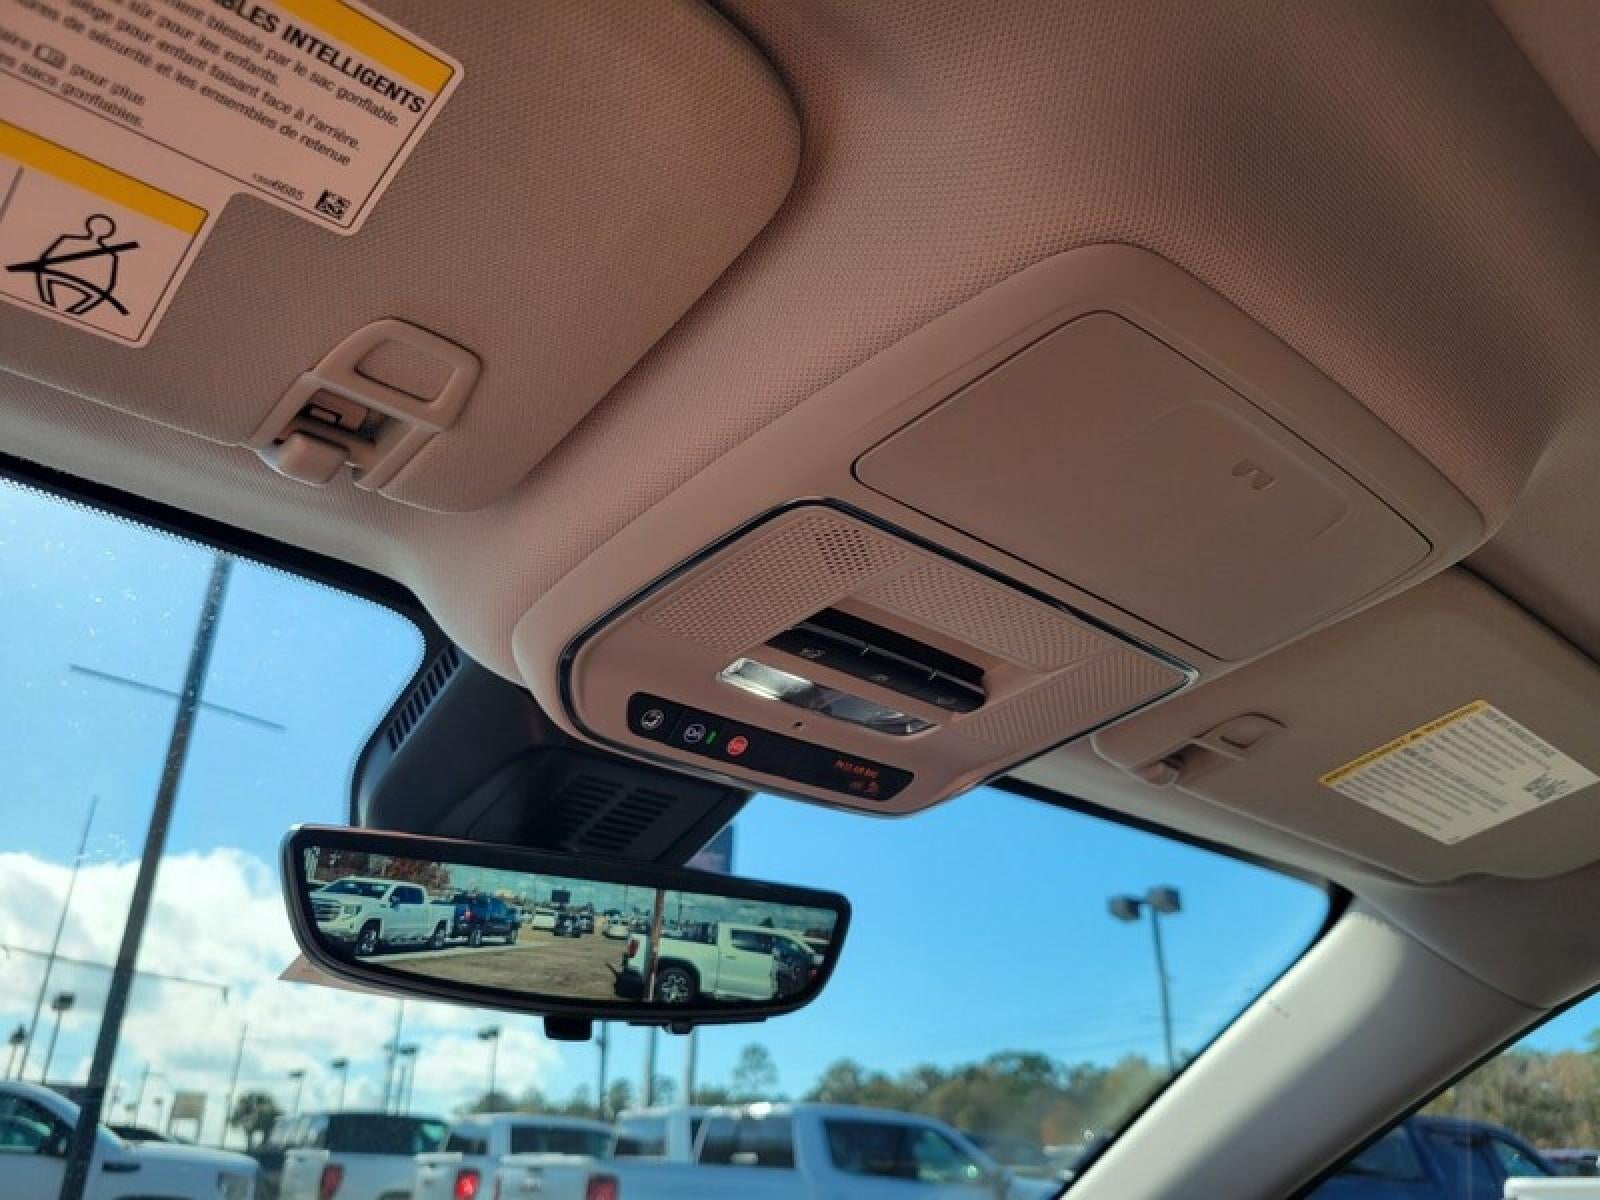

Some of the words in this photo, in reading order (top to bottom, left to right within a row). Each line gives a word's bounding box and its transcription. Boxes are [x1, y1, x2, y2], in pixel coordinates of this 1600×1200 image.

[115, 18, 153, 42] pour
[157, 39, 208, 71] enfant
[210, 64, 260, 98] faisant
[262, 91, 292, 114] face
[157, 15, 193, 40] pour
[198, 33, 221, 54] les
[214, 0, 279, 33] BLES
[282, 24, 425, 113] INTELLIGENTS
[70, 63, 109, 88] pour
[109, 81, 145, 106] plus
[265, 48, 291, 67] par
[293, 62, 308, 77] le
[310, 72, 336, 92] sac
[155, 62, 173, 78] et
[174, 69, 198, 90] les
[199, 85, 278, 129] ensembles
[279, 124, 299, 139] de
[300, 135, 351, 165] retenue
